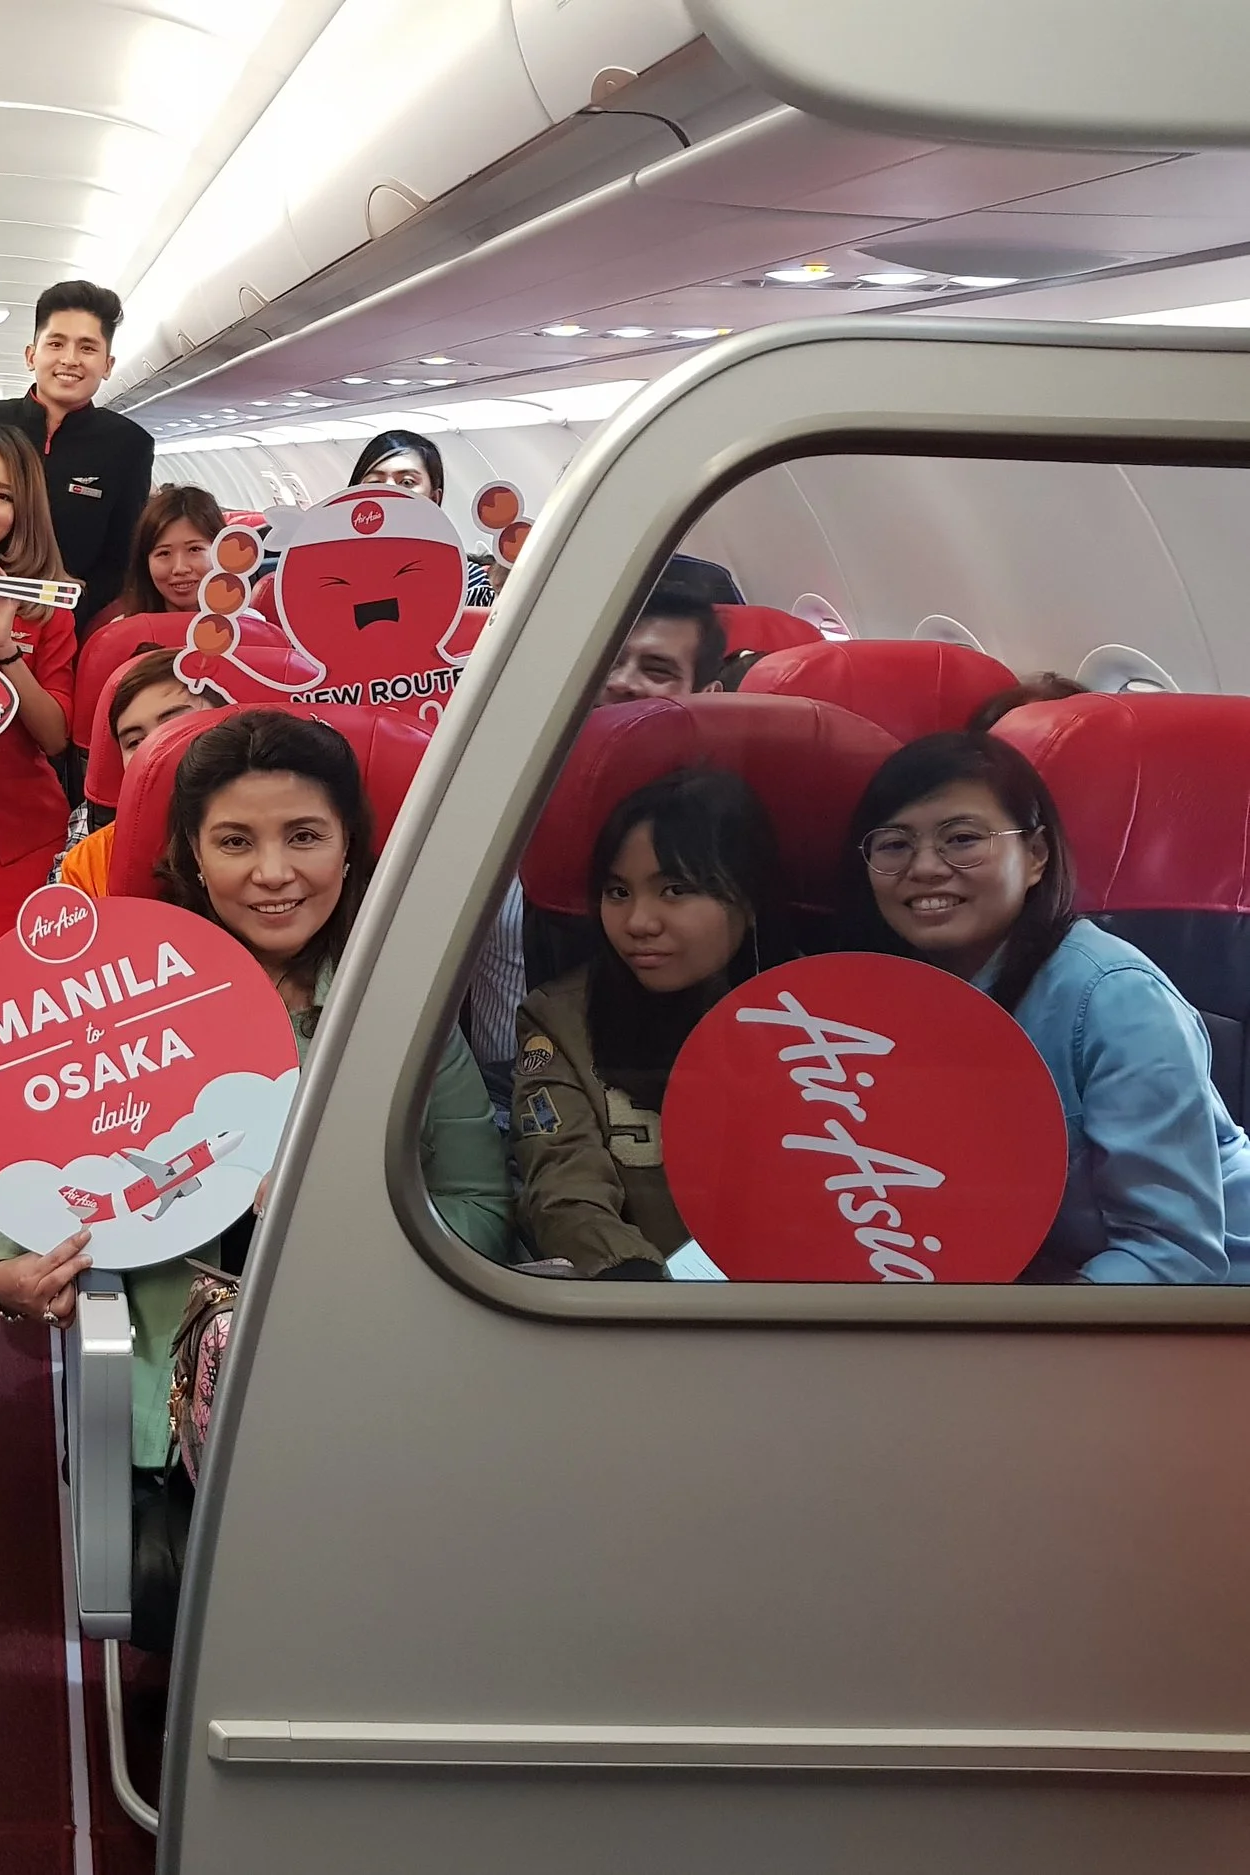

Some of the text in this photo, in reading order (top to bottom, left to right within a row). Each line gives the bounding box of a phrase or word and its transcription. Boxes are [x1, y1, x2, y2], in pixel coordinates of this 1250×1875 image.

[293, 685, 360, 705] EW
[29, 906, 88, 946] AirAsia
[86, 1022, 105, 1044] to
[24, 1028, 195, 1112] OSAKA
[91, 1092, 151, 1135] daily
